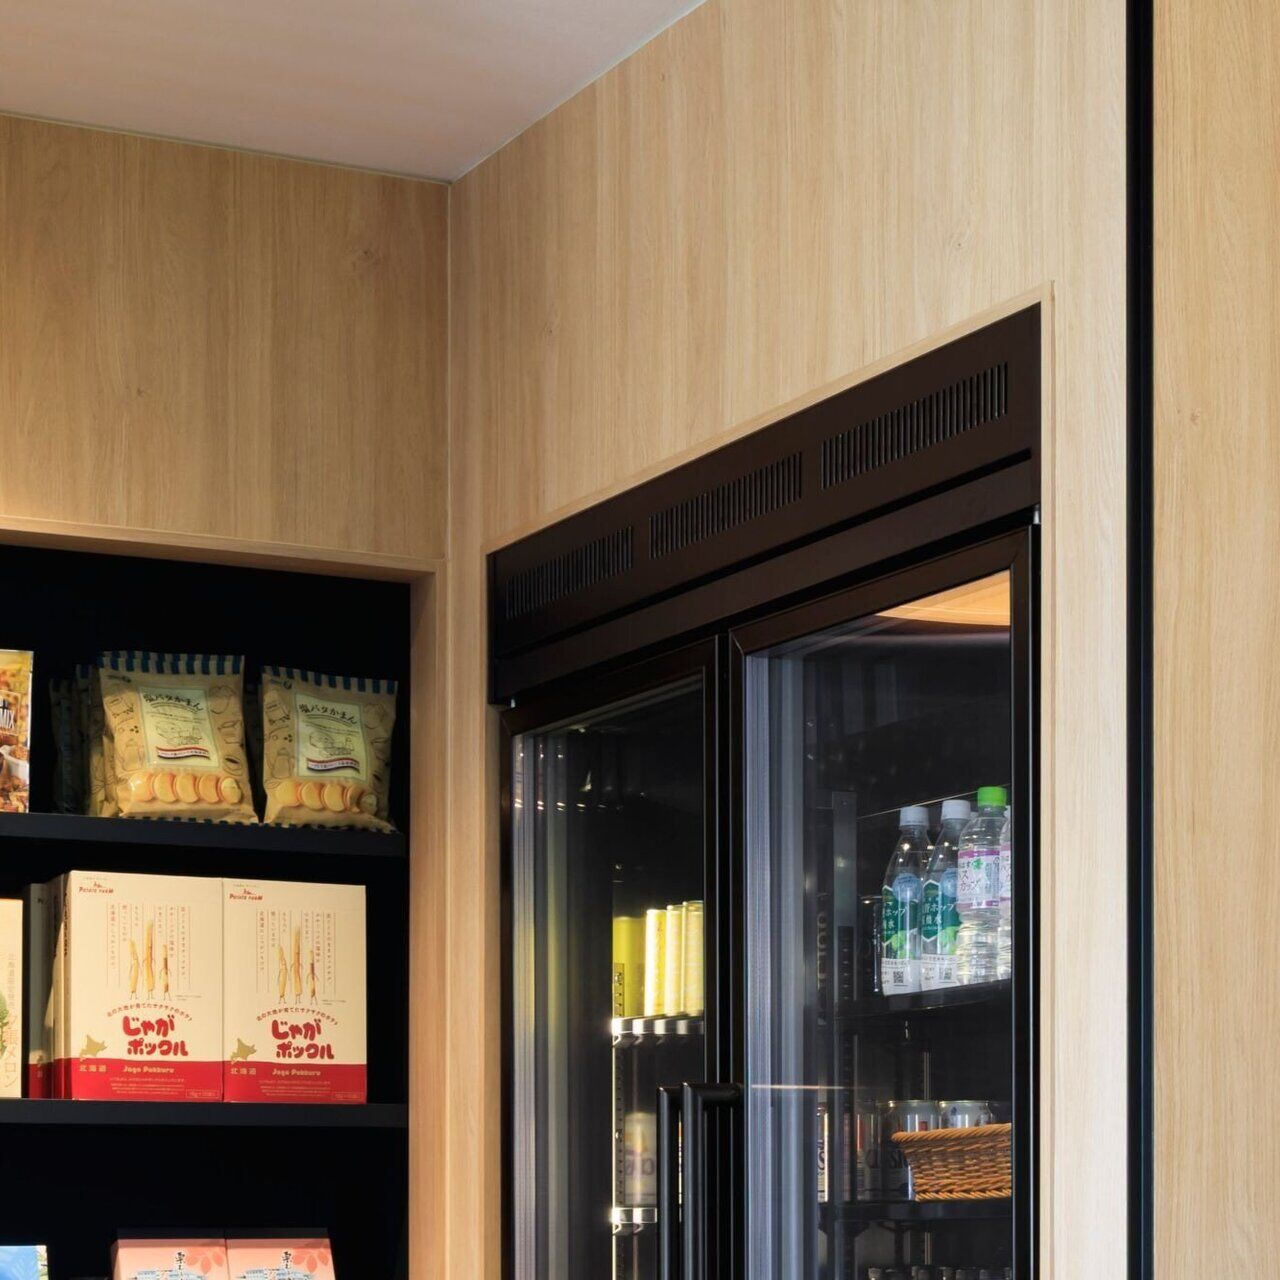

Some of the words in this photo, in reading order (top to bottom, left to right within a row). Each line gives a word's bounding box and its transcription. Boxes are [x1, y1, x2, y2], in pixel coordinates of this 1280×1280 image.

[0, 709, 16, 729] MIX
[122, 1014, 176, 1037] じゃが
[271, 1018, 322, 1041] じゃが
[127, 1038, 189, 1057] ポックル
[276, 1041, 335, 1060] ポックル
